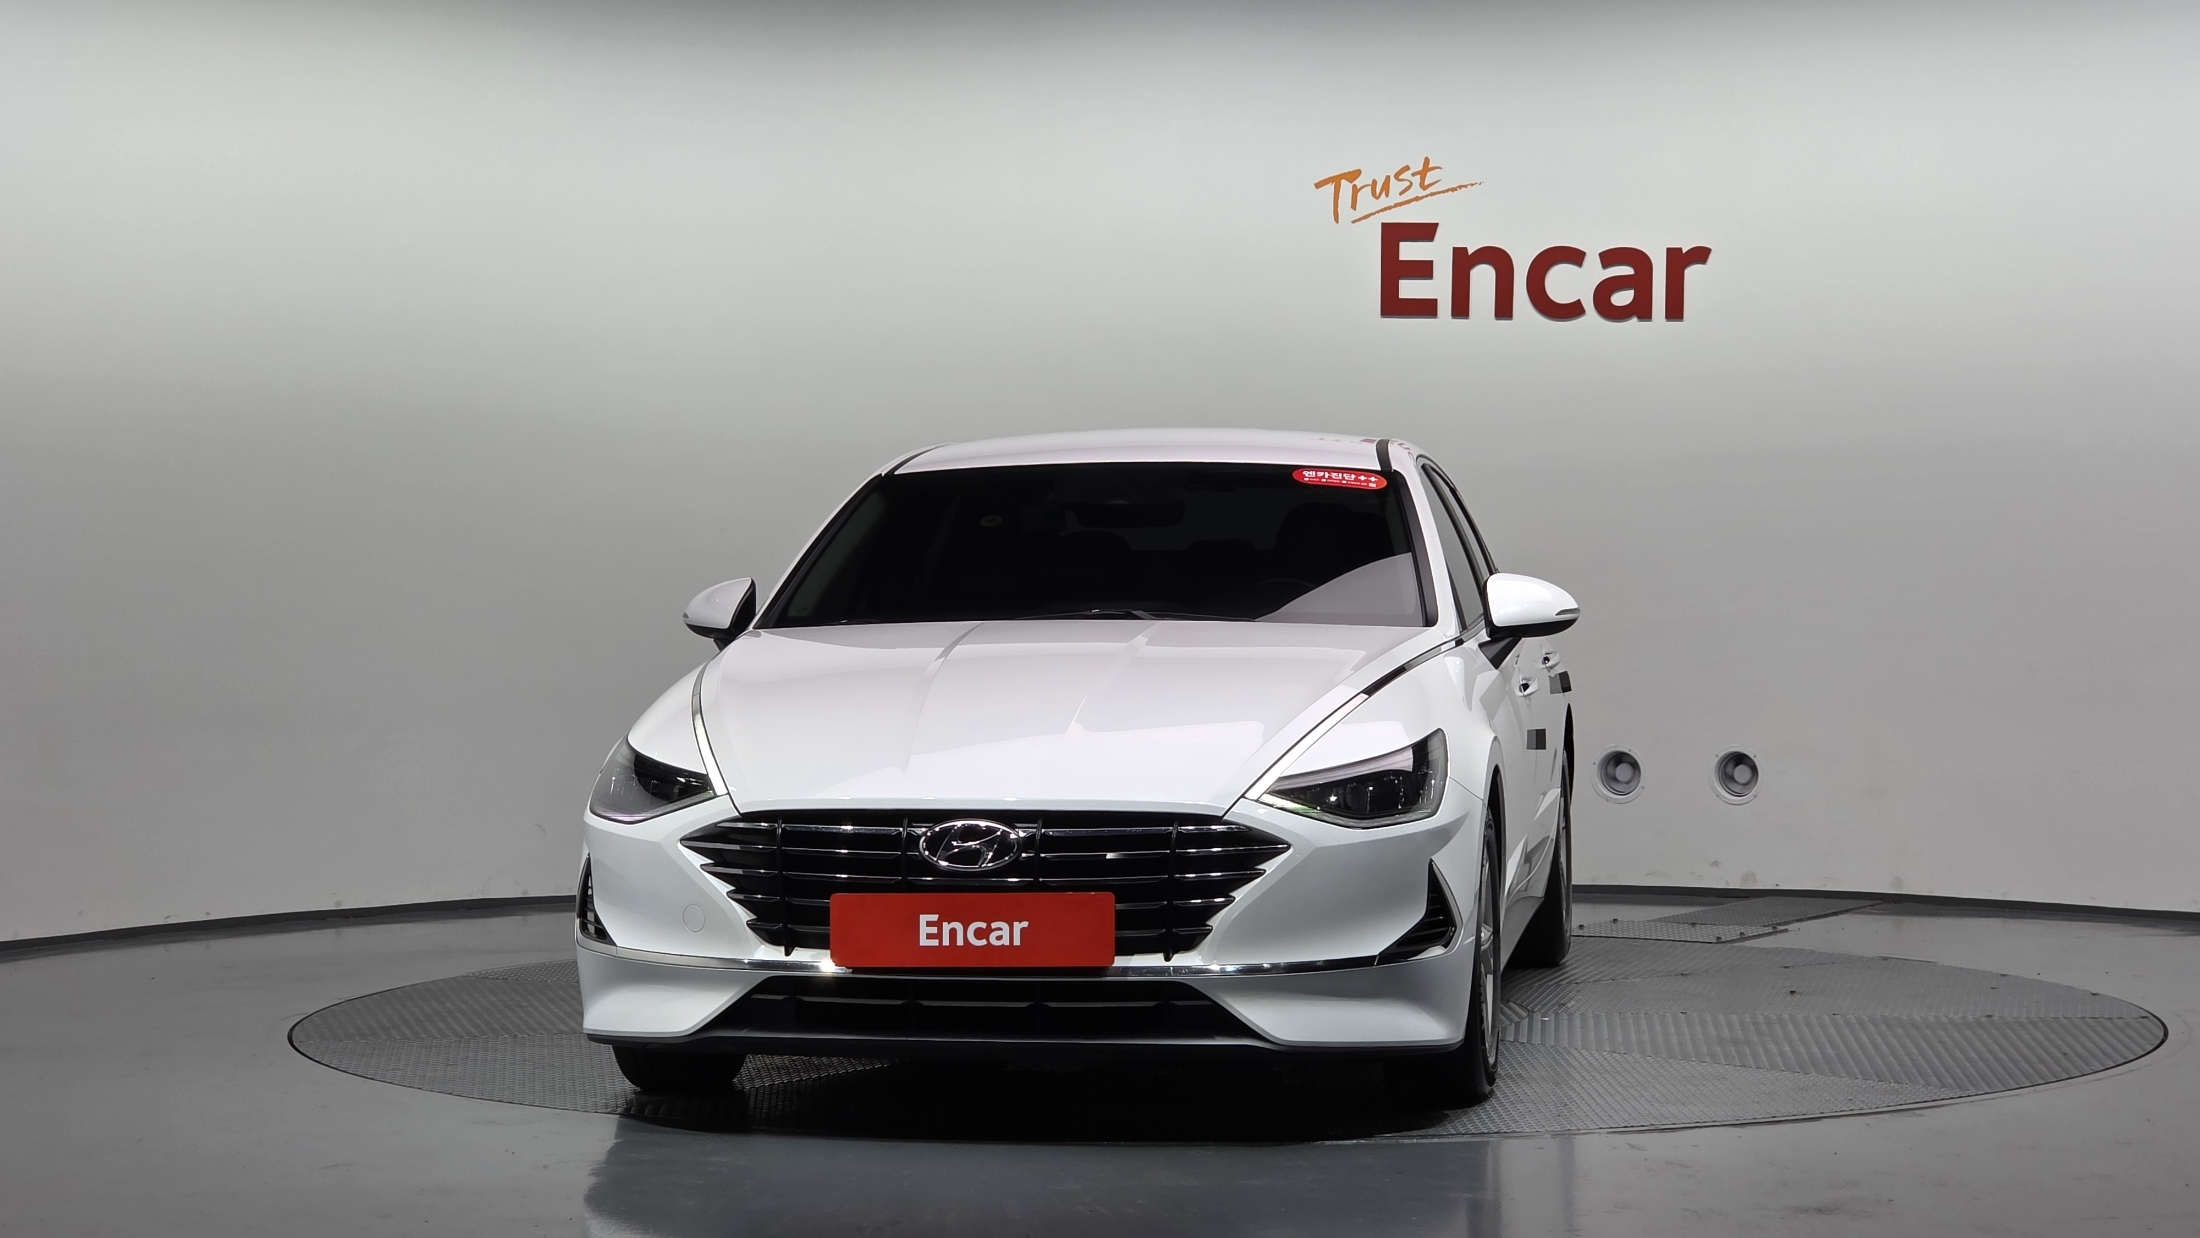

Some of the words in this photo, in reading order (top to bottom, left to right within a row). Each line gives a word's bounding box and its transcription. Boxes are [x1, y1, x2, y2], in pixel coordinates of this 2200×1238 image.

[1314, 156, 1443, 224] Trust
[1380, 222, 1712, 322] Encar
[919, 914, 1029, 946] Encar
